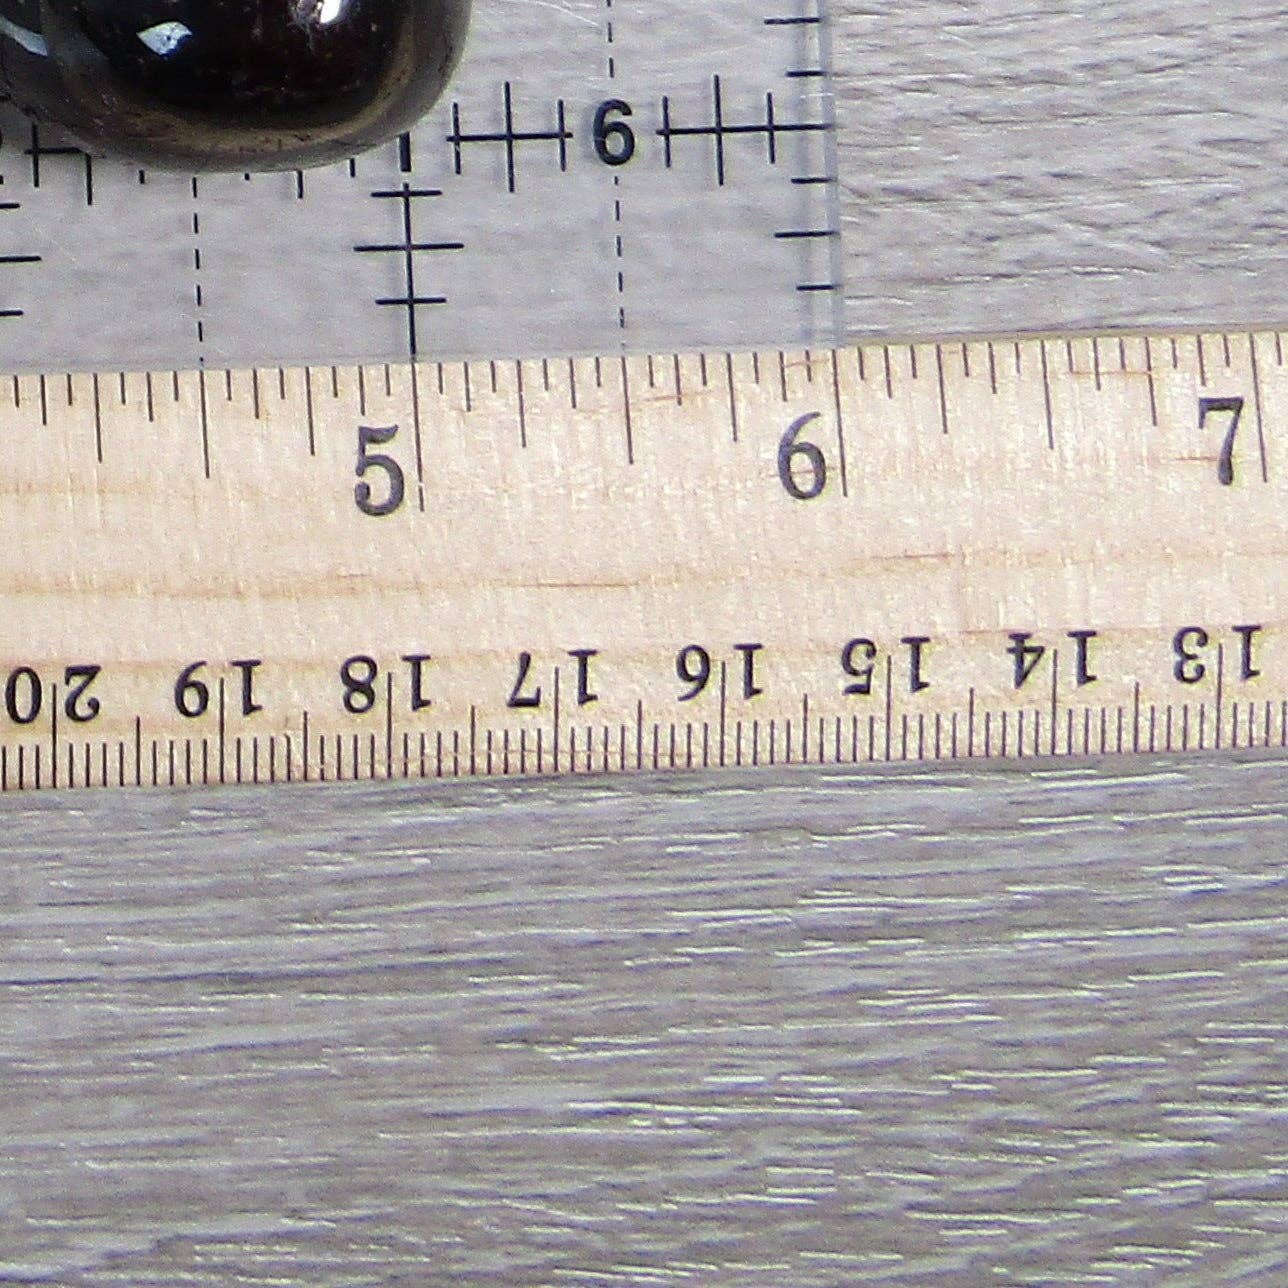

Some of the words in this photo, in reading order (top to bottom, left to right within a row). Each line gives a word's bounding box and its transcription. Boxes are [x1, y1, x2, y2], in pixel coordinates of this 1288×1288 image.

[592, 98, 636, 168] 6
[354, 425, 406, 516] 5
[777, 411, 829, 501] 6
[1198, 396, 1245, 487] 7
[340, 655, 433, 714] 18
[507, 649, 600, 709] 17
[676, 643, 765, 702] 16
[842, 636, 933, 695] 15
[1006, 630, 1098, 689] 14
[1173, 626, 1263, 684] 13
[6, 665, 103, 724] 20
[175, 659, 264, 718] 19
